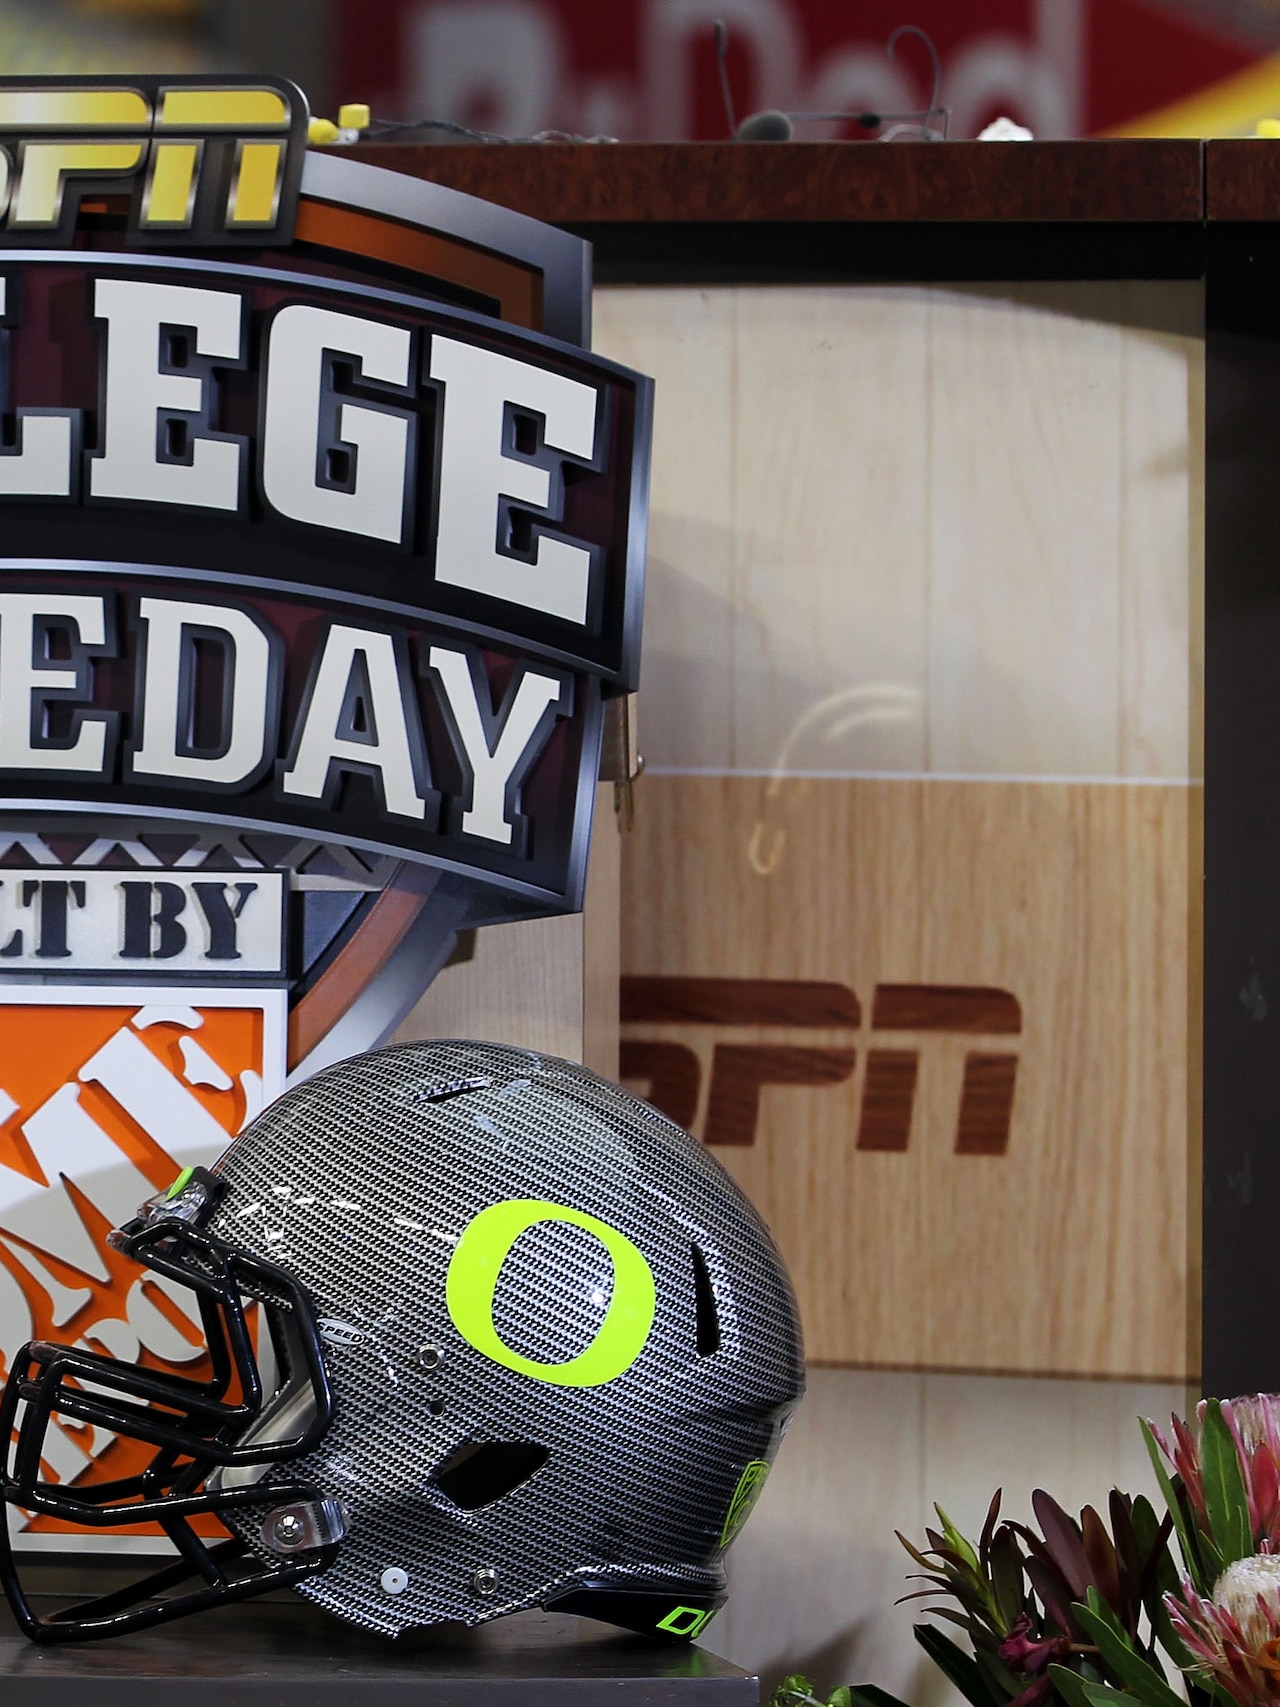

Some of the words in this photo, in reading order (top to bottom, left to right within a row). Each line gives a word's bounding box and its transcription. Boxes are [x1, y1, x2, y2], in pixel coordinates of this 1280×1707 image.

[119, 881, 258, 958] BY
[318, 1321, 363, 1343] SPEED
[446, 1199, 655, 1388] O
